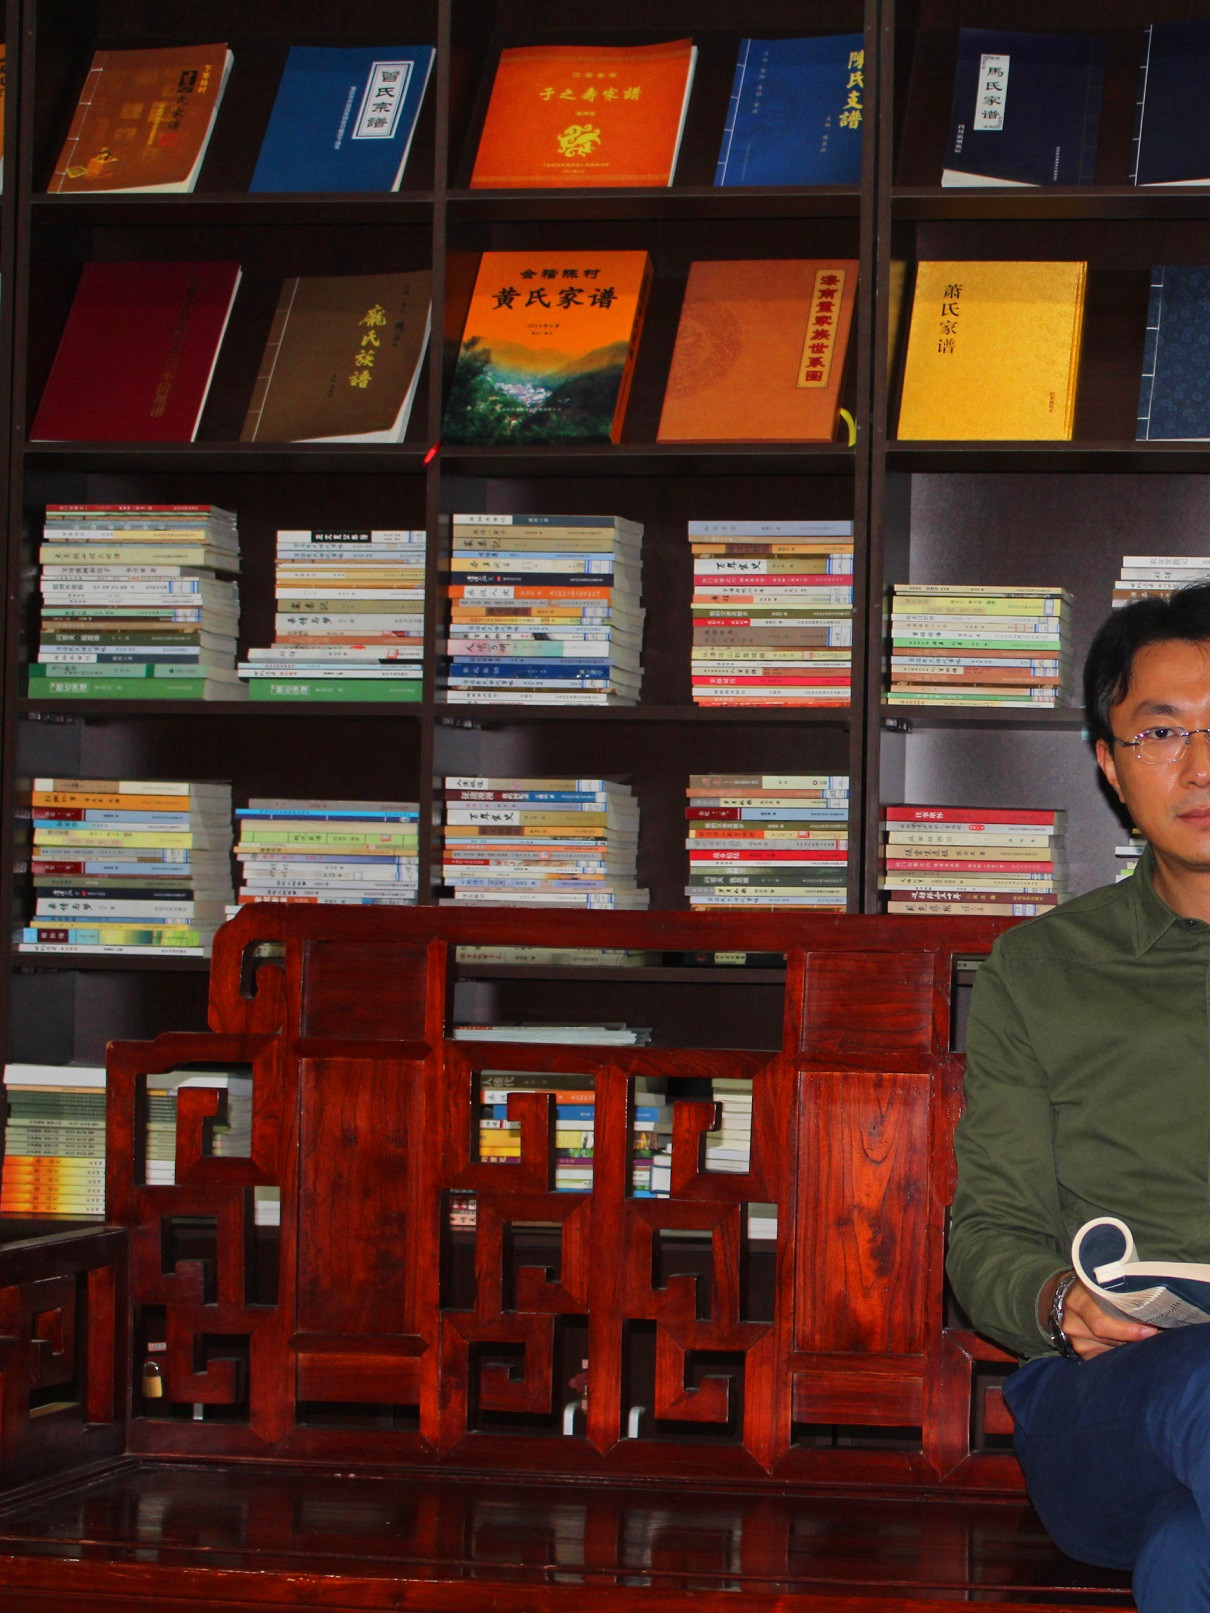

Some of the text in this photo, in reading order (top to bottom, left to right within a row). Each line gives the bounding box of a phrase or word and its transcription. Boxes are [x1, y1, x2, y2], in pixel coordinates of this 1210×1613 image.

[981, 67, 1004, 119] 馬氏家谱
[492, 286, 618, 310] 黄氏家谱
